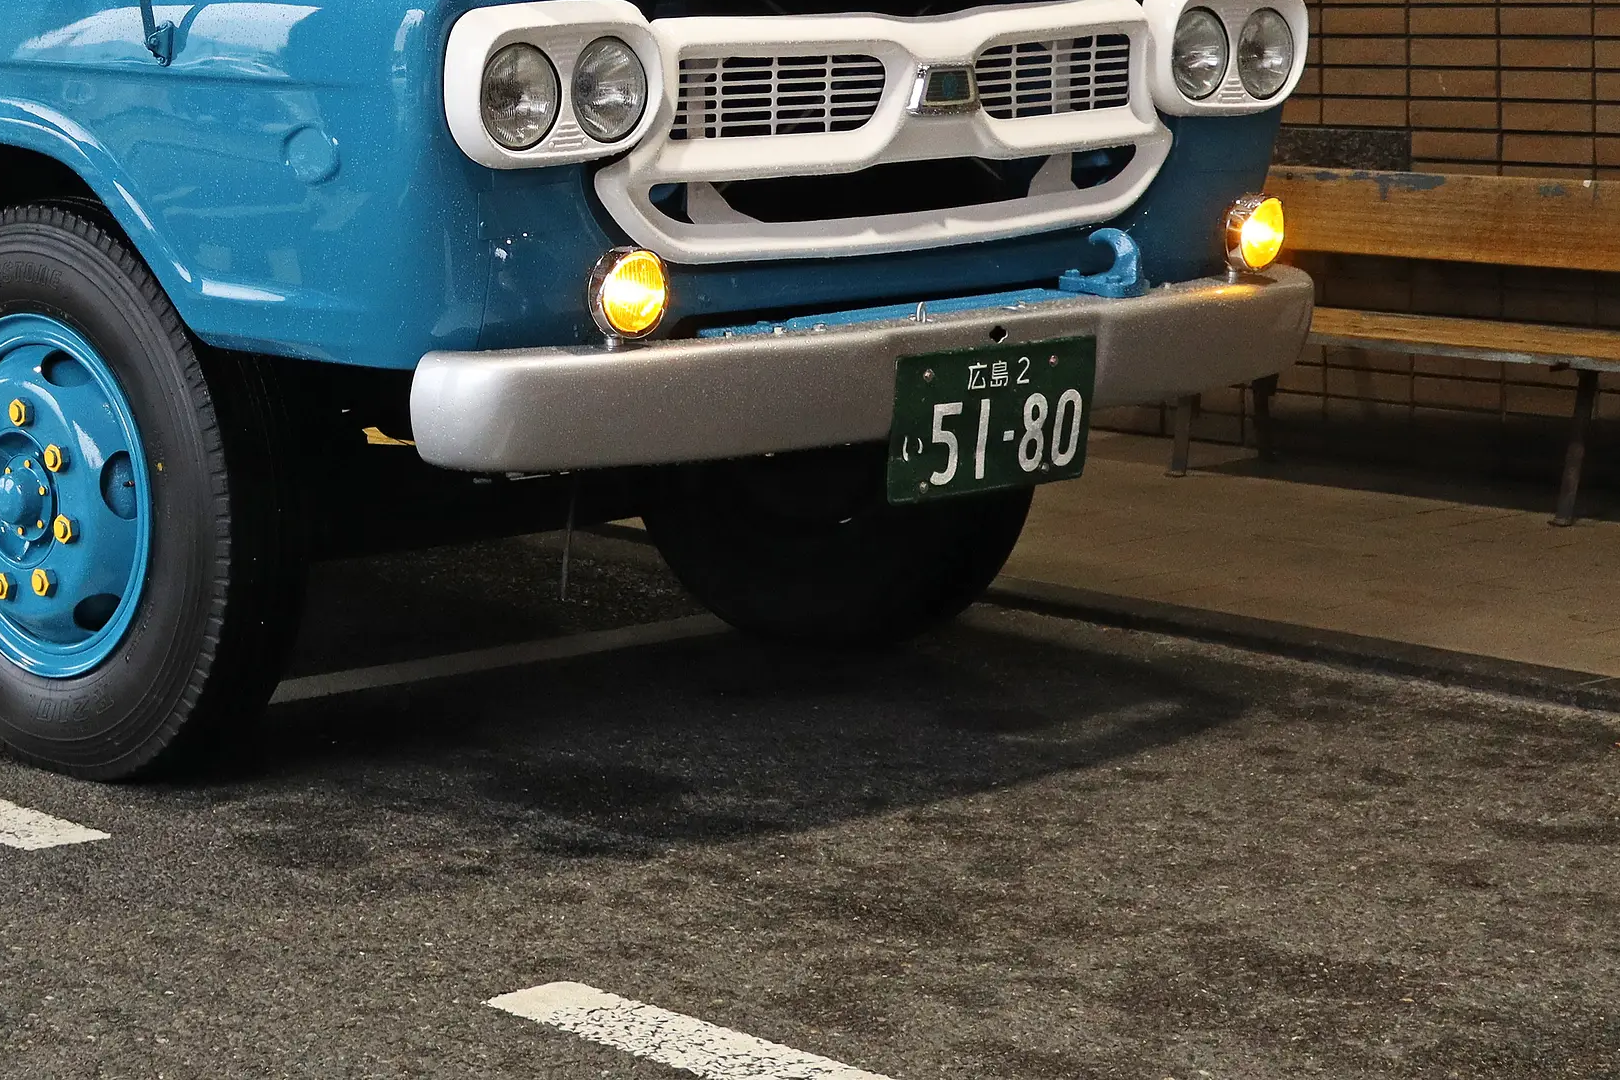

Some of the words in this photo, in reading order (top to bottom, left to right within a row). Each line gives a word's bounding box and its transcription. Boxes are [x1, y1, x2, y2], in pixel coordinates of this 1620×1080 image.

[966, 360, 1010, 391] 広島
[1016, 356, 1031, 385] 2
[901, 434, 924, 462] い
[928, 388, 1083, 486] 51-80
